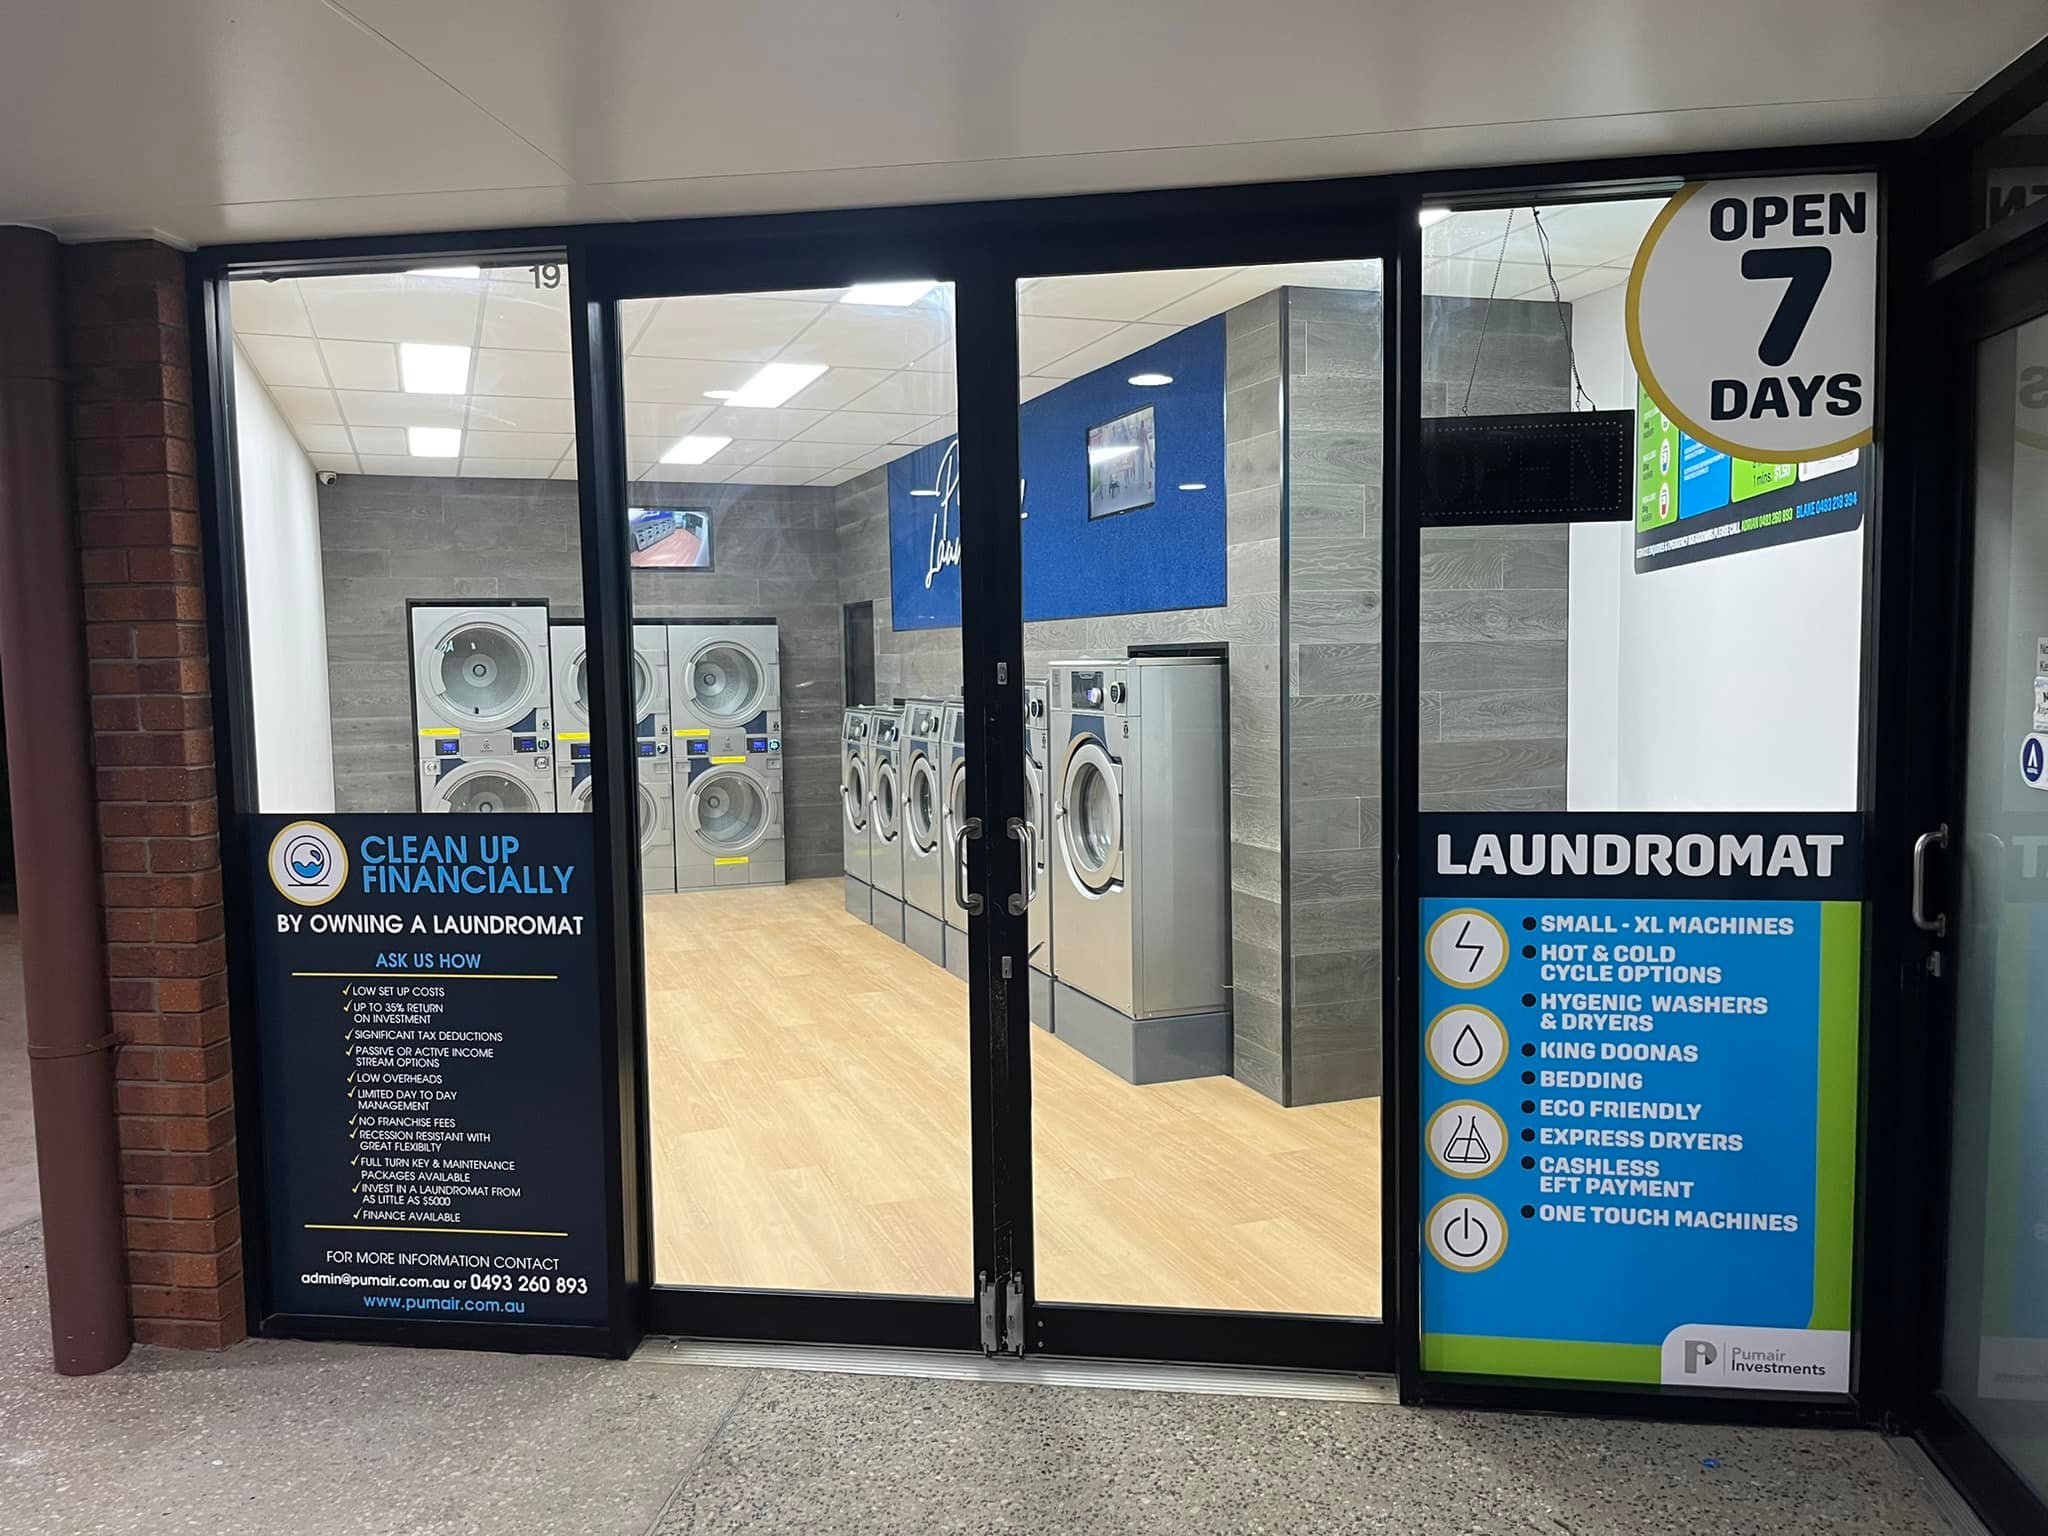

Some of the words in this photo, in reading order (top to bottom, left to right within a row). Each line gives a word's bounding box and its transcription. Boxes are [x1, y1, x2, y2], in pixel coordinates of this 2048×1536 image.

[1711, 192, 1866, 243] OPEN
[529, 263, 560, 288] 19
[1741, 246, 1831, 366] 7
[1711, 374, 1861, 420] DAYS
[1796, 502, 1815, 518] BLAKE
[361, 836, 467, 863] CLEAN
[480, 836, 519, 863] UP
[1438, 834, 1843, 876] LAUNDROMAT
[363, 866, 574, 893] FINANCIALLY
[278, 914, 302, 932] BY
[310, 915, 403, 933] OWNING
[411, 915, 426, 933] A
[434, 915, 583, 934] LAUNDROMAT
[1541, 915, 1617, 932] SMALL
[1635, 916, 1663, 933] XL
[1669, 917, 1793, 935] MACHINES
[376, 953, 408, 967] ASK
[414, 953, 433, 968] US
[440, 954, 480, 968] HOW
[1542, 944, 1588, 961] HOT
[1592, 945, 1608, 961] &
[1614, 945, 1675, 962] COLD
[1541, 964, 1613, 981] CYCLE
[1618, 965, 1721, 983] OPTIONS
[353, 986, 376, 996] LOW
[379, 987, 393, 996] SET
[397, 987, 409, 996] UP
[412, 987, 445, 997] COSTS
[354, 1003, 366, 1012] UP
[369, 1003, 382, 1012] TO
[385, 1003, 404, 1012] 35%
[407, 1003, 443, 1013] RETURN
[1541, 993, 1641, 1011] HYGENIC
[1652, 995, 1767, 1014] WASHERS
[354, 1014, 370, 1023] ON
[373, 1014, 431, 1024] INVESTMENT
[1541, 1013, 1556, 1029] &
[1562, 1013, 1653, 1031] DRYERS
[355, 1030, 415, 1039] SIGNIFICANT
[418, 1031, 436, 1040] TAX
[439, 1031, 503, 1041] DEDUCTIONS
[356, 1046, 394, 1056] PASSIVE
[397, 1047, 412, 1056] OR
[415, 1047, 449, 1057] ACTIVE
[452, 1048, 493, 1058] INCOME
[1541, 1042, 1595, 1059] KING
[1601, 1043, 1698, 1062] DOONAS
[356, 1057, 394, 1066] STREAM
[397, 1058, 439, 1068] OPTIONS
[357, 1073, 380, 1082] LOW
[383, 1074, 442, 1084] OVERHEADS
[1541, 1071, 1642, 1089] BEDDING
[358, 1090, 393, 1099] LIMITED
[396, 1090, 417, 1099] DAY
[420, 1090, 433, 1100] TO
[436, 1091, 457, 1100] DAY
[358, 1101, 429, 1110] MANAGEMENT
[1541, 1100, 1584, 1117] ECO
[1590, 1101, 1701, 1120] FRIENDLY
[359, 1117, 375, 1126] NO
[378, 1117, 431, 1127] FRANCHISE
[434, 1118, 455, 1128] FEES
[360, 1130, 413, 1140] RECESSION
[416, 1131, 464, 1141] RESISTANT
[467, 1133, 490, 1142] WITH
[1541, 1128, 1644, 1147] EXPRESS
[1650, 1132, 1742, 1151] DRYERS
[360, 1141, 392, 1150] GREAT
[395, 1142, 441, 1152] FLEXIBILTY
[361, 1157, 382, 1167] FULL
[385, 1158, 409, 1167] TURN
[412, 1159, 429, 1168] KEY
[433, 1159, 440, 1168] &
[443, 1160, 515, 1170] MAINTENANCE
[1540, 1157, 1659, 1180] CASHLESS
[362, 1170, 415, 1181] PACKAGES
[418, 1172, 470, 1182] AVAILABLE
[362, 1184, 393, 1193] INVEST
[397, 1185, 406, 1193] IN
[409, 1185, 417, 1193] A
[420, 1185, 488, 1195] LAUNDROMAT
[492, 1187, 520, 1197] FROM
[1540, 1176, 1581, 1193] EFT
[1586, 1178, 1694, 1198] PAYMENT
[363, 1195, 375, 1204] AS
[378, 1195, 404, 1204] LITTLE
[407, 1196, 420, 1205] AS
[423, 1196, 451, 1206] $5000
[363, 1210, 405, 1220] FINANCE
[408, 1212, 460, 1222] AVAILABLE
[1540, 1205, 1585, 1222] ONE
[1590, 1206, 1669, 1226] TOUCH
[1675, 1210, 1797, 1231] MACHINES
[327, 1251, 352, 1263] FOR
[357, 1252, 394, 1264] MORE
[399, 1253, 489, 1267] INFORMATION
[494, 1257, 559, 1270] CONTACT
[301, 1272, 449, 1288] admin@pumair.com.au
[454, 1280, 467, 1289] or
[471, 1274, 512, 1291] 0493
[518, 1276, 550, 1292] 260
[556, 1277, 587, 1294] 893
[364, 1296, 524, 1313] www.pumair.com.au
[1732, 1347, 1786, 1362] Pumair
[1732, 1360, 1826, 1376] Investments
